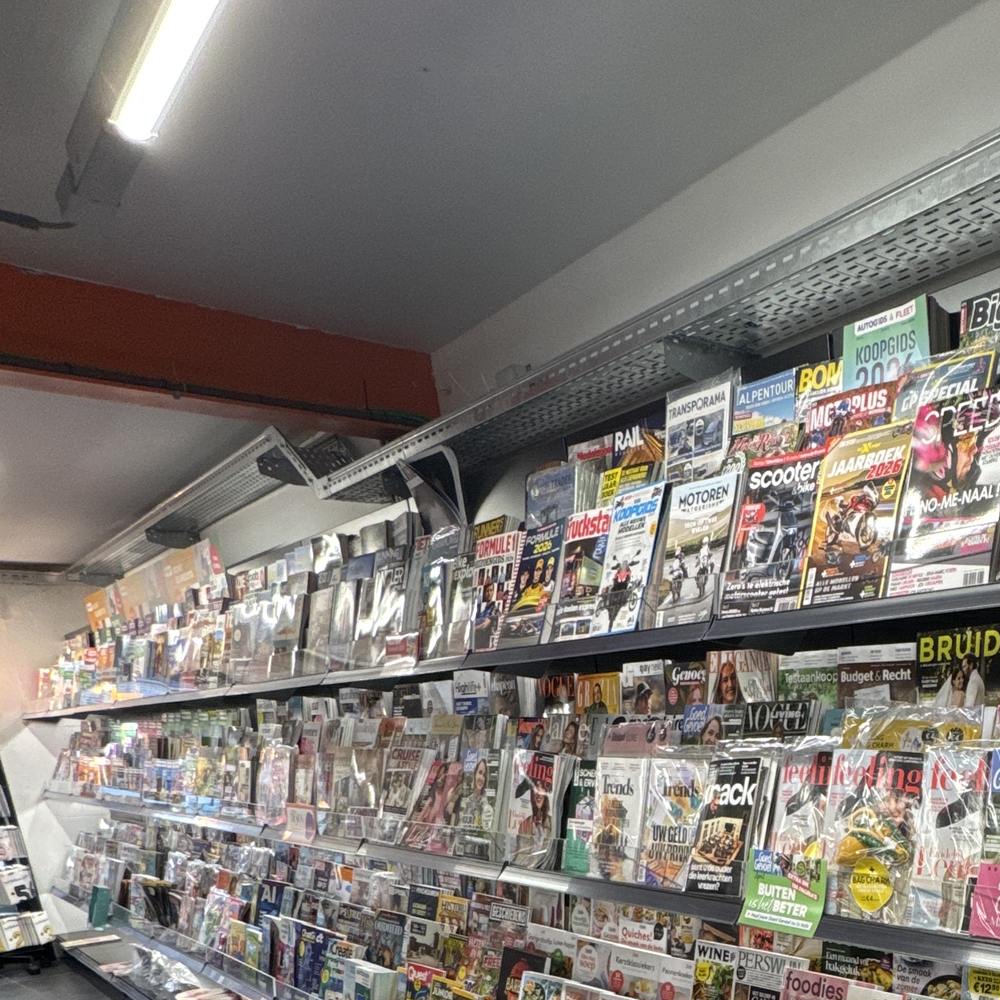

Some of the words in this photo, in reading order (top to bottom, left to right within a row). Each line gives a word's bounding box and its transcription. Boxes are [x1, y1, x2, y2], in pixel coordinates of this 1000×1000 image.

[856, 330, 917, 365] KOOPGIDS
[668, 390, 727, 419] TRANSPORAMA
[615, 425, 644, 452] RAIL
[750, 460, 819, 489] scooter
[866, 459, 902, 480] 2026
[678, 482, 729, 508] MOTOREN
[841, 670, 872, 684] Budget
[882, 668, 912, 682] Recht
[602, 774, 634, 796] Trends
[758, 882, 796, 901] BUITEN
[772, 900, 808, 918] BETER
[786, 971, 844, 1000] foodies
